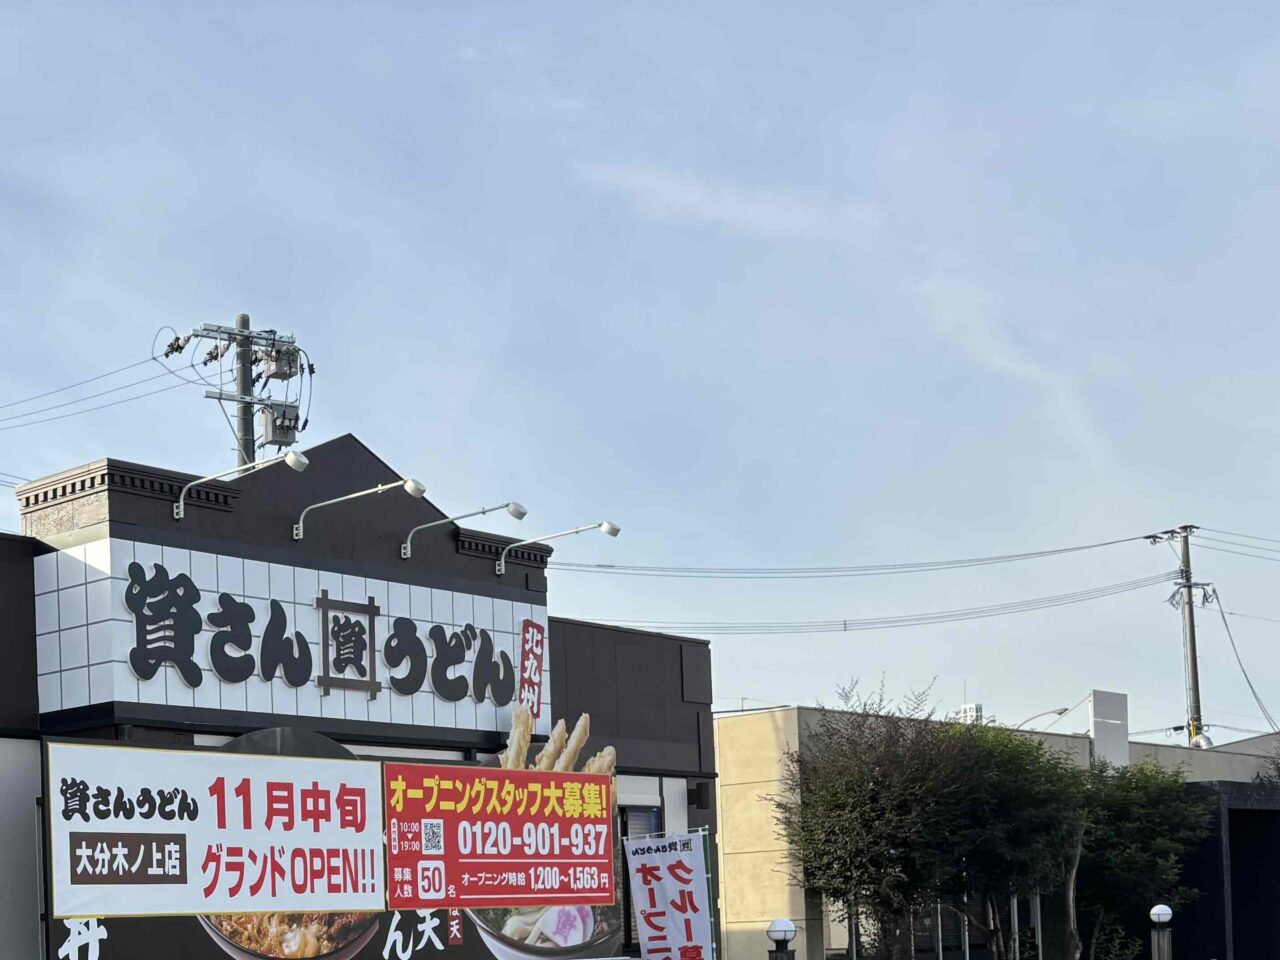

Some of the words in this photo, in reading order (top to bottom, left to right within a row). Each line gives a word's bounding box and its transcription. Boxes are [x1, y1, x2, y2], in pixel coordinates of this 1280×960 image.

[384, 616, 516, 707] うどん
[521, 626, 543, 714] 北九州
[60, 777, 199, 822] 資さんうどん
[208, 776, 367, 833] 11月中旬
[400, 822, 420, 833] 10:00
[457, 820, 608, 856] 0120-901-937
[75, 840, 181, 876] 大分木ノ上店
[400, 841, 420, 851] 19:00
[394, 867, 412, 882] 募集
[394, 884, 413, 898] 人数
[421, 866, 442, 894] 50
[447, 885, 456, 898] 名
